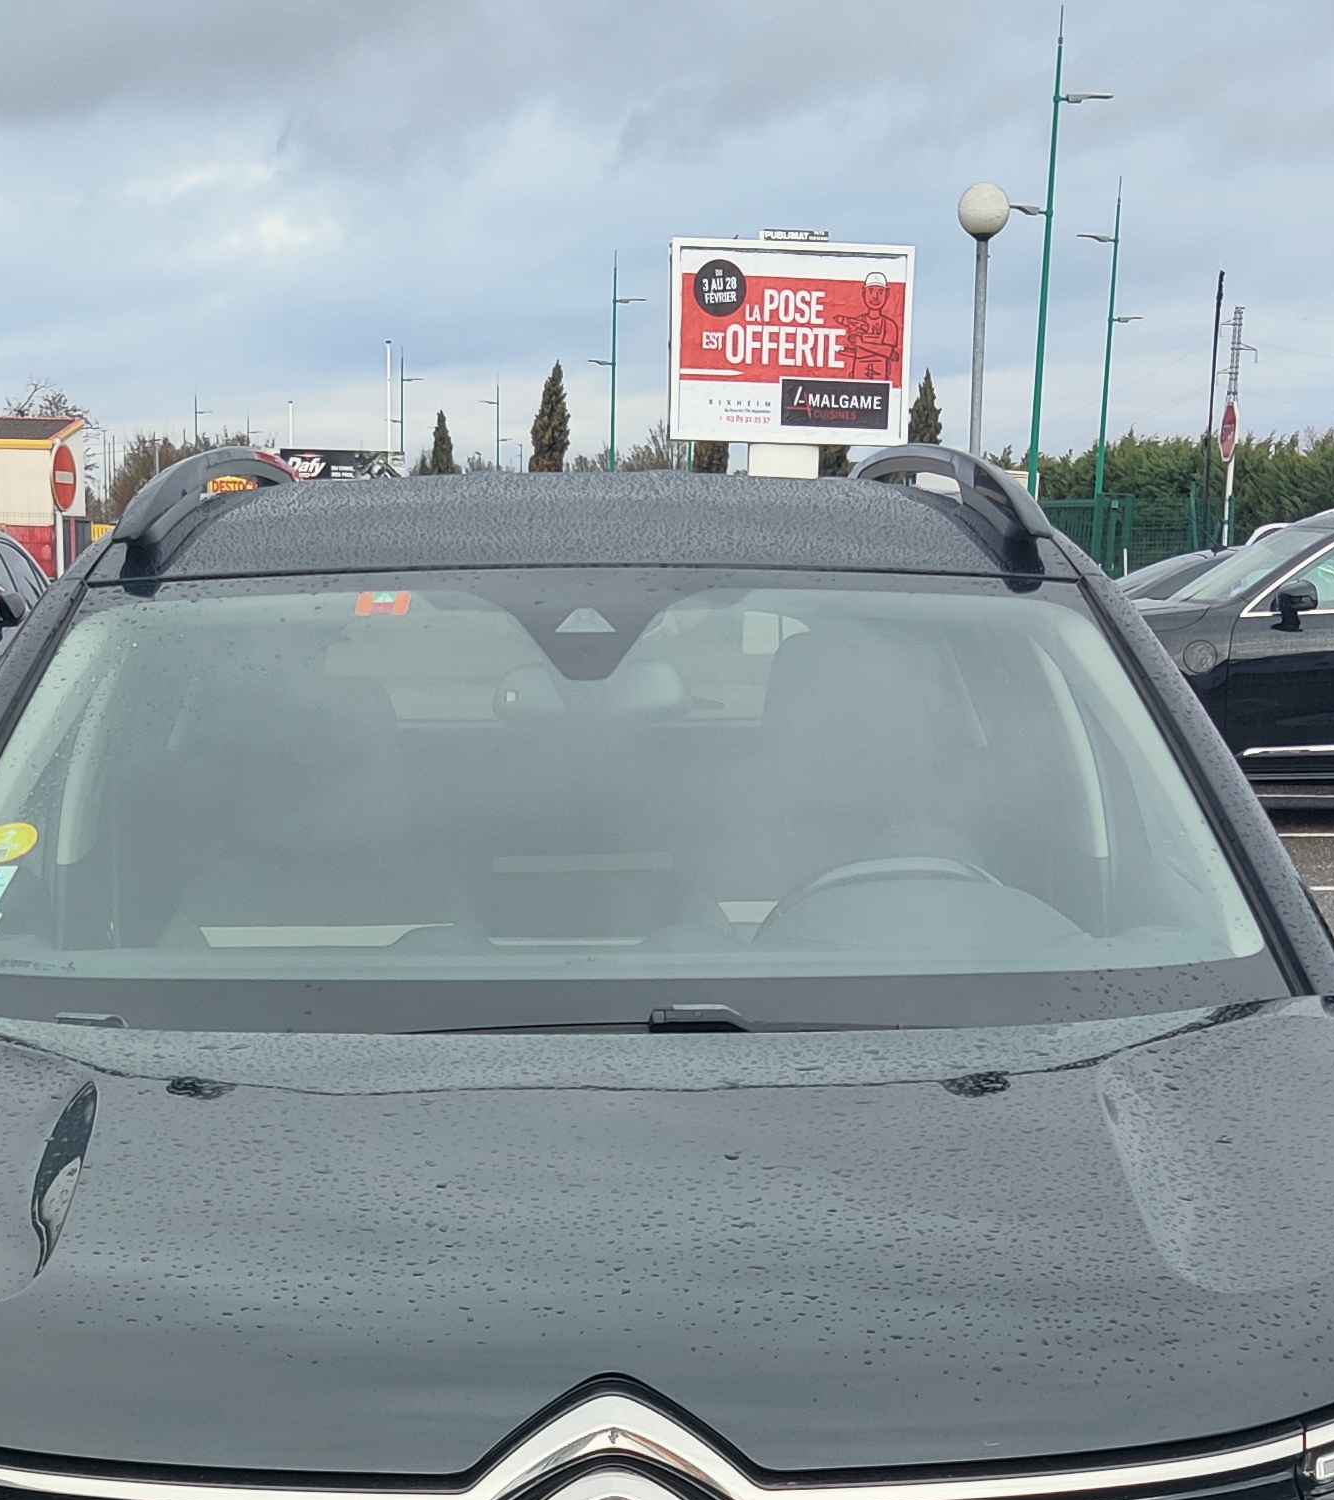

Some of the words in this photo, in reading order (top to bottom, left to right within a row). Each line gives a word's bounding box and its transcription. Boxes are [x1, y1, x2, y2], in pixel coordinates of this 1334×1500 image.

[702, 278, 709, 292] 3
[711, 278, 724, 291] AU
[725, 277, 738, 290] 28
[745, 303, 761, 323] LA
[763, 288, 825, 325] POSE
[701, 331, 725, 351] EST
[725, 323, 846, 369] OFFERTE
[786, 385, 882, 415] AMALGAME
[813, 410, 858, 421] CUISINES
[288, 456, 327, 478] Dafy
